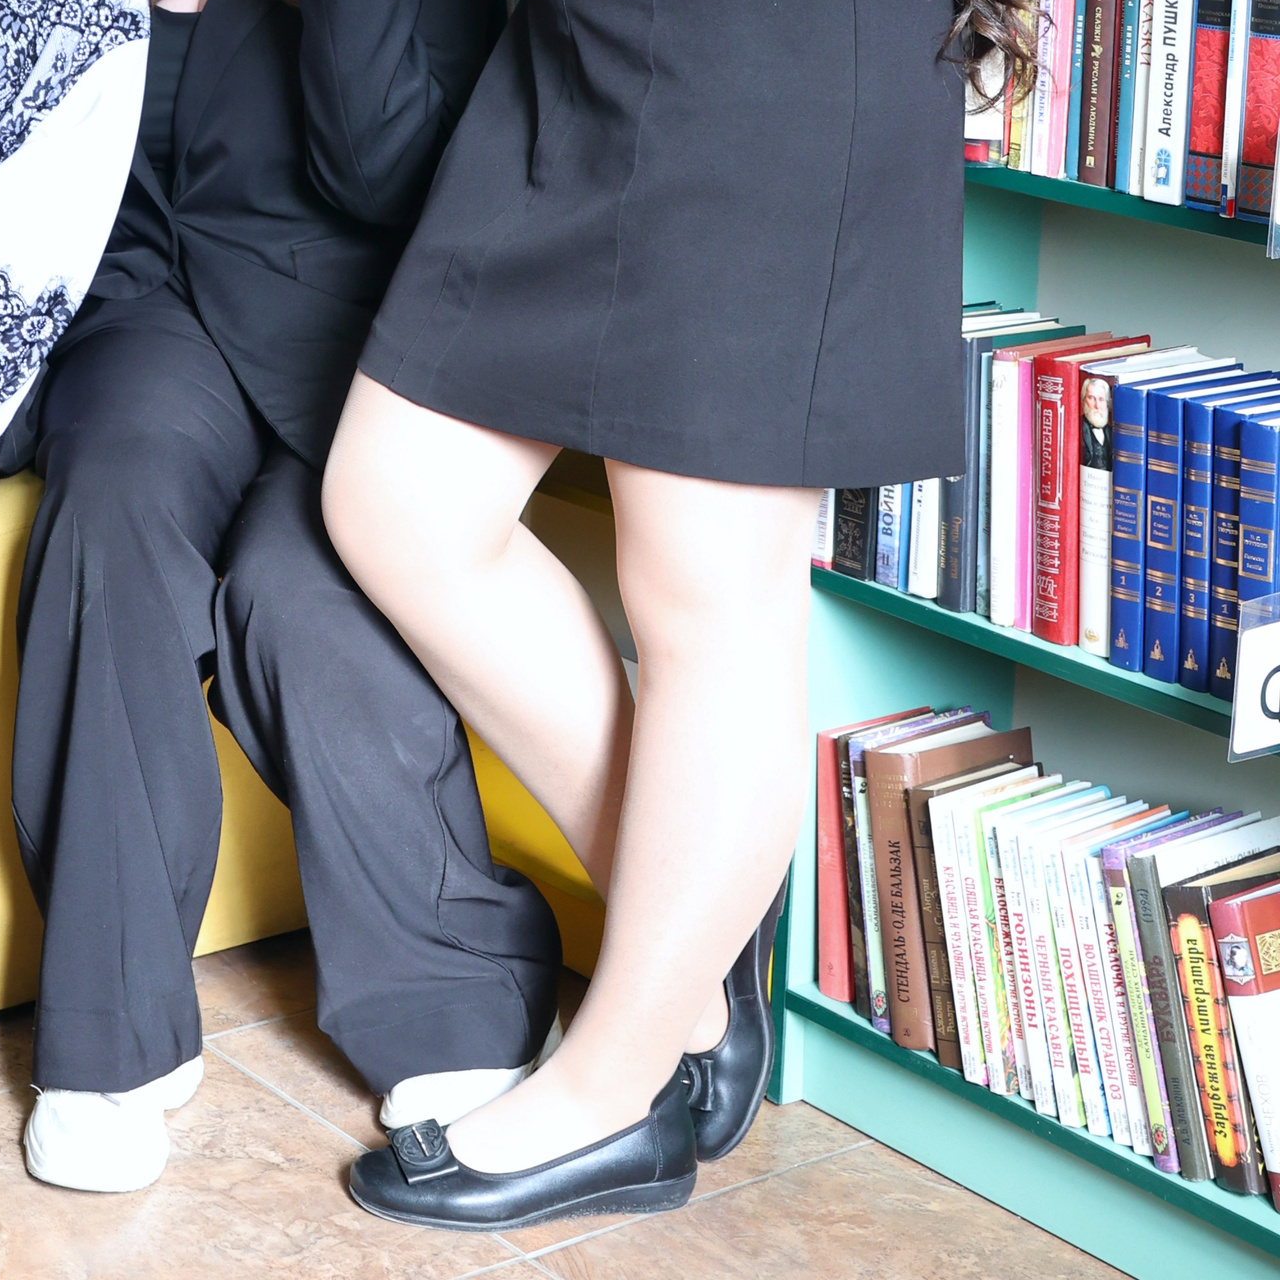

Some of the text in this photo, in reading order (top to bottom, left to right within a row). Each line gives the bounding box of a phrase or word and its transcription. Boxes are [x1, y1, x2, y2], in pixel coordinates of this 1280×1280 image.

[1075, 15, 1084, 55] ПУШКИН
[1125, 24, 1133, 65] ПУШКИН
[1087, 6, 1103, 151] СКАЗКИ РУСЛАН ЛЮДМИЛА
[1157, 53, 1178, 138] Александр
[1040, 408, 1053, 496] И. ТУРГЕНЕВ
[1120, 575, 1126, 585] 1
[1155, 586, 1162, 596] 2
[1189, 593, 1195, 602] 3
[1222, 604, 1228, 613] 1
[888, 840, 910, 1003] СТЕНДАЛЬ БАЛЬЗАК
[943, 866, 959, 920] КРАСАВИЦА
[963, 876, 987, 982] СПЯЩАЯ КРАСАВИЦА
[993, 877, 1014, 957] БЕЛОСНЕЖКА
[950, 930, 967, 982] ЧУДОВИЩЕ
[1013, 911, 1038, 1029] РОБИНЗОНЫ
[1103, 922, 1126, 998] РУСАЛОЧКА
[1136, 888, 1176, 1044] БУКВАРЬ (1994)
[1035, 934, 1065, 1069] ЧЕРНЫЙ КРАСАВЕЦ
[1060, 946, 1092, 1076] ПОХИЩЕННЫЙ
[1083, 942, 1119, 1081] ВОЛШЕБНИК СТРАНЫ
[1128, 949, 1152, 1060] СКАНДИНАВСКИХ СТРАН
[1184, 937, 1227, 1140] Зарубежная литература
